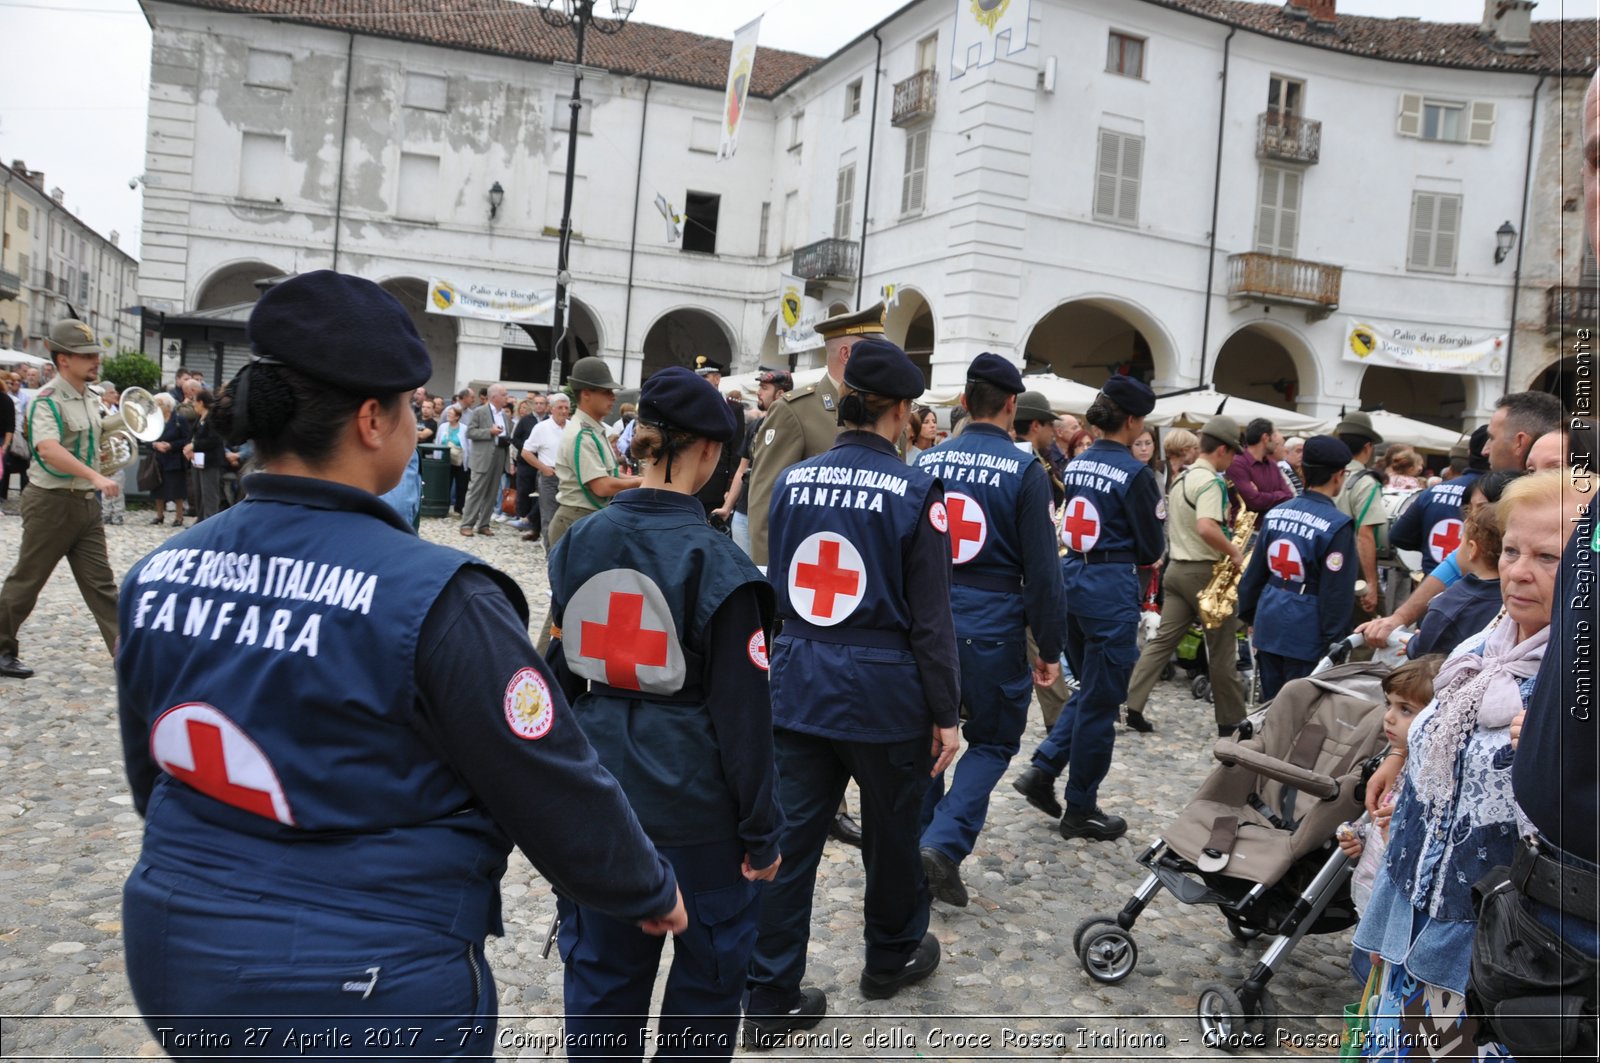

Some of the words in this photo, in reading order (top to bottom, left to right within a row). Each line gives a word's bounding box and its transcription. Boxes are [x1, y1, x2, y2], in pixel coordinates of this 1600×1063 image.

[1393, 328, 1416, 342] Palio
[1420, 332, 1435, 343] dei
[1439, 334, 1472, 347] Borghi
[919, 451, 946, 467] CROCE
[945, 450, 976, 467] ROSSA
[976, 453, 1019, 474] ITALIANA
[1095, 462, 1129, 485] ITALIANA
[786, 466, 818, 486] CROCE
[816, 466, 853, 486] ROSSA
[852, 469, 908, 497] ITALIANA
[924, 464, 1001, 488] FANFARA
[1064, 473, 1112, 495] FANFARA
[789, 487, 883, 513] FANFARA
[1267, 519, 1315, 541] FANFARA
[1300, 511, 1331, 533] ITALIANA
[191, 549, 261, 594] ROSSA
[262, 556, 378, 616] ITALIANA
[133, 590, 323, 658] FANFARA
